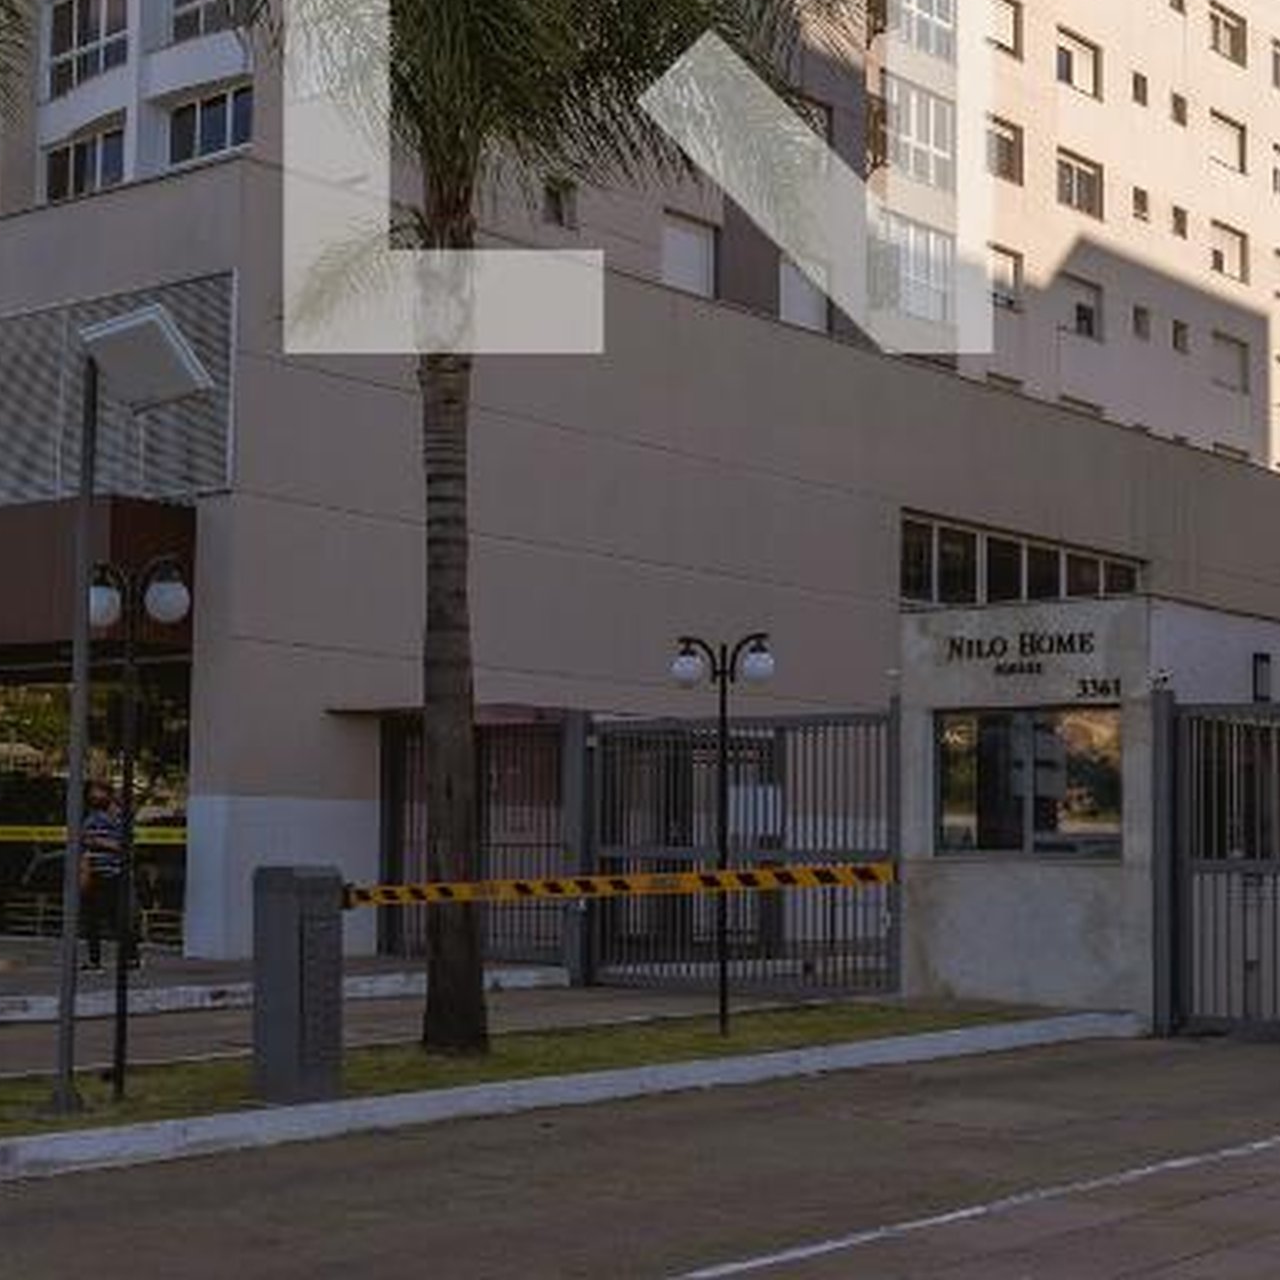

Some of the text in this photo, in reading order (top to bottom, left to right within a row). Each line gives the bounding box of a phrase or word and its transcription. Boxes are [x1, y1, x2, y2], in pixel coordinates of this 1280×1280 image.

[947, 631, 1094, 662] NILO HOME
[1076, 679, 1121, 698] 3361
